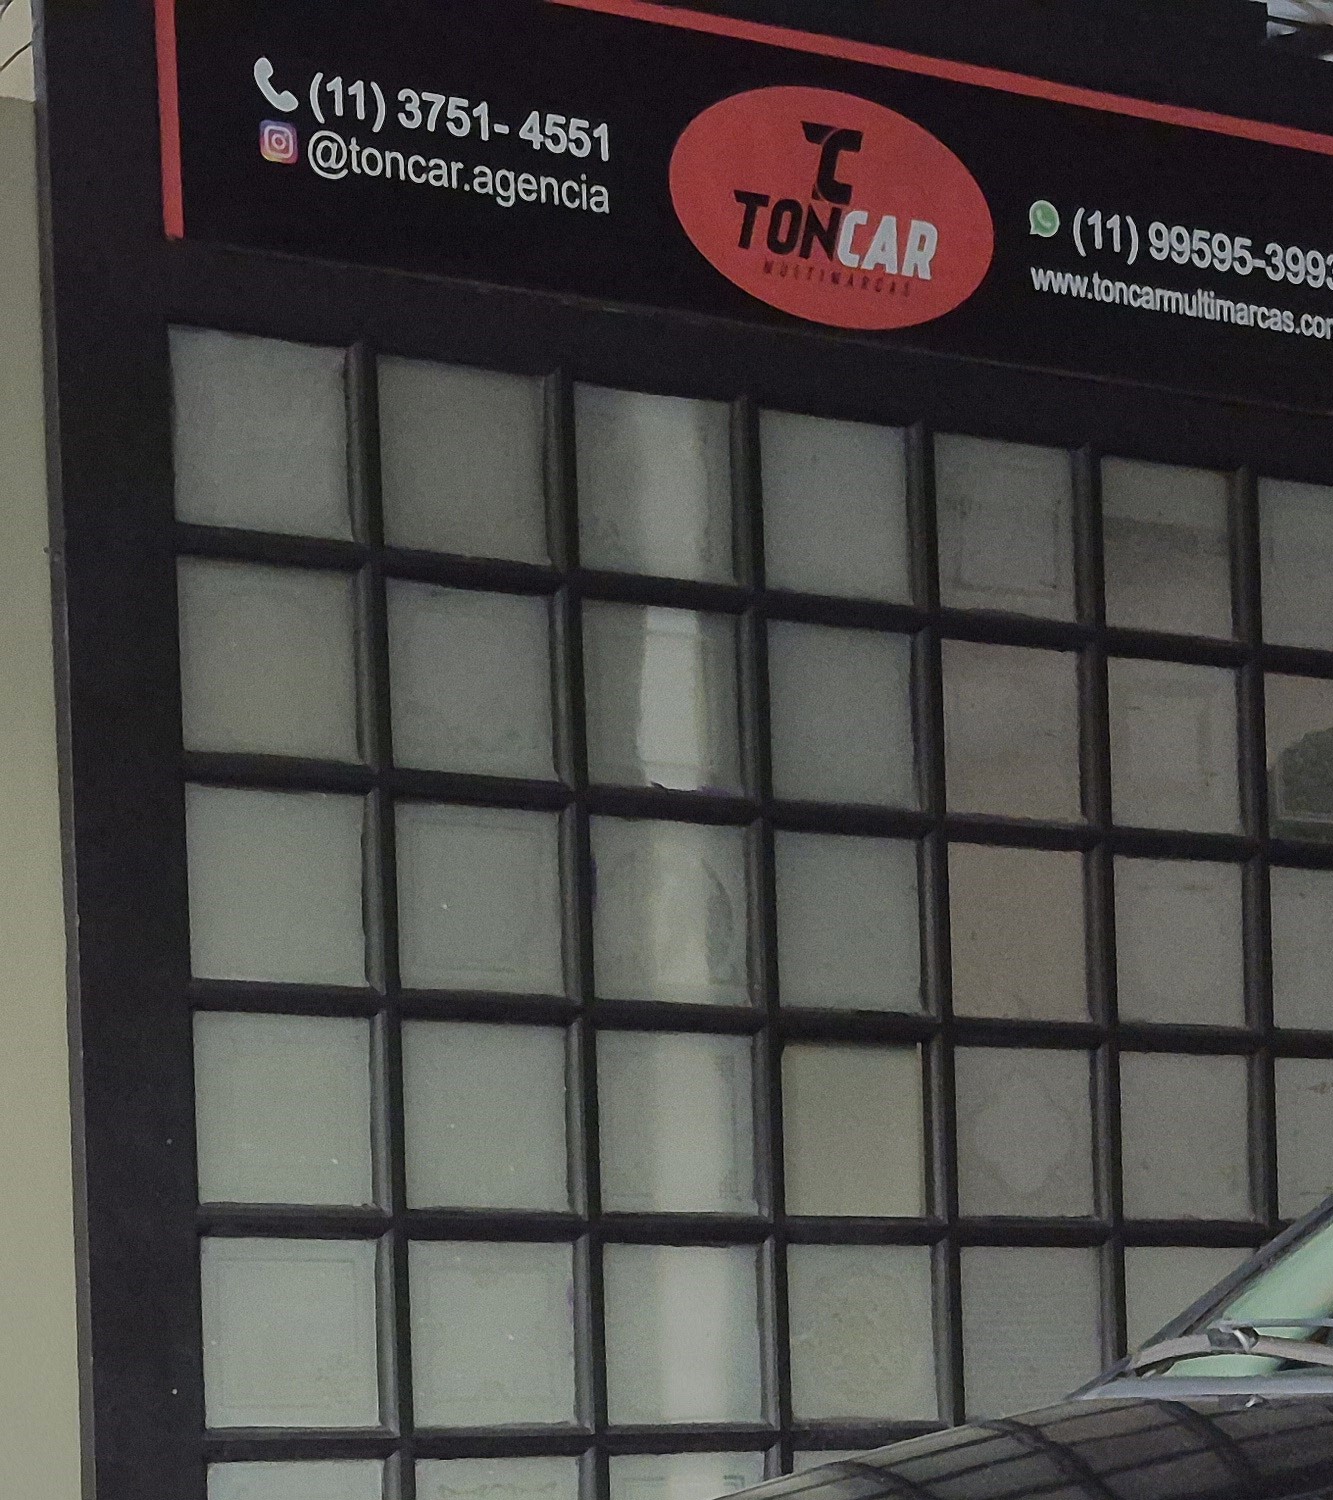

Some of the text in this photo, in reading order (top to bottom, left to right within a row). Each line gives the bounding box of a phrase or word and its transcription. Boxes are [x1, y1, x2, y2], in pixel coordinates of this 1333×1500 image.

[309, 72, 609, 162] (11) 3751- 4551
[307, 129, 610, 215] @toncar.agencia
[733, 188, 939, 281] TONCAR
[1072, 206, 1139, 266] (11)
